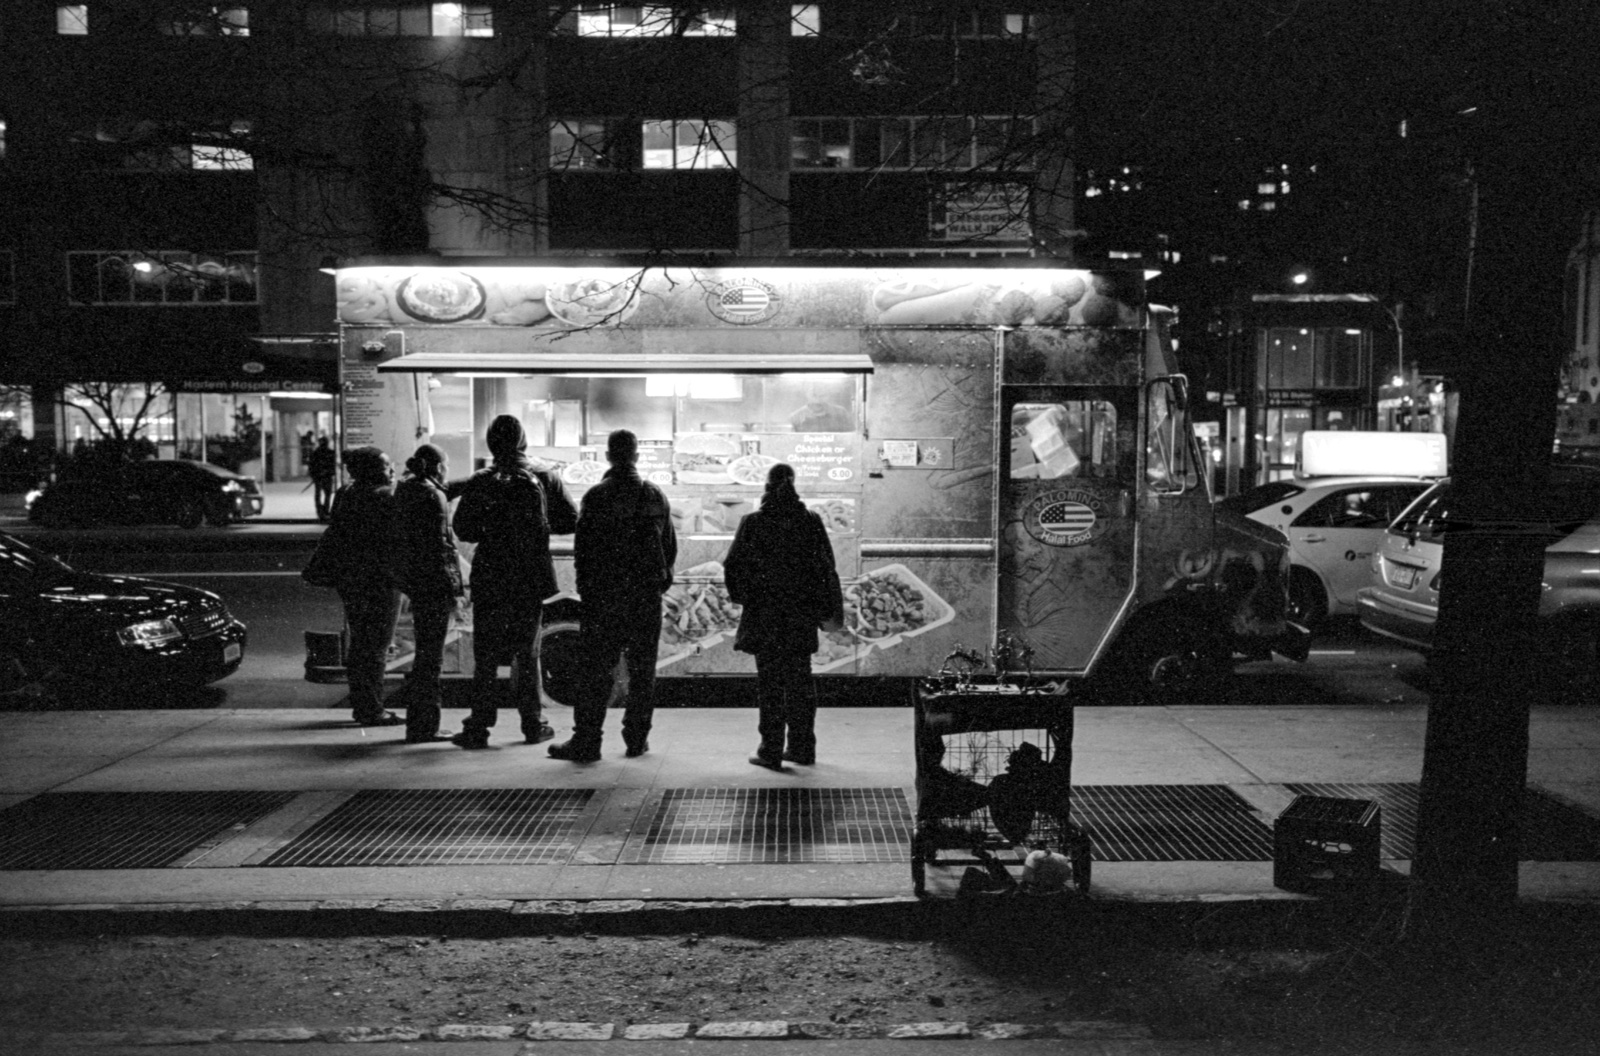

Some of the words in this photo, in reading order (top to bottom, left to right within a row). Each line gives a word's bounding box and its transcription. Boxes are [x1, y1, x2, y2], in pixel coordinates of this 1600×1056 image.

[184, 380, 227, 390] Harlem
[231, 380, 280, 391] Hospital
[283, 380, 324, 391] Center
[803, 434, 834, 444] Special
[795, 444, 833, 453] Chicken
[787, 454, 853, 465] Cheeseburger
[652, 473, 671, 481] 6.00
[831, 469, 851, 478] 5.00
[1033, 490, 1101, 511] PALOMINO
[1040, 530, 1066, 545] Halal
[1067, 531, 1092, 545] Food
